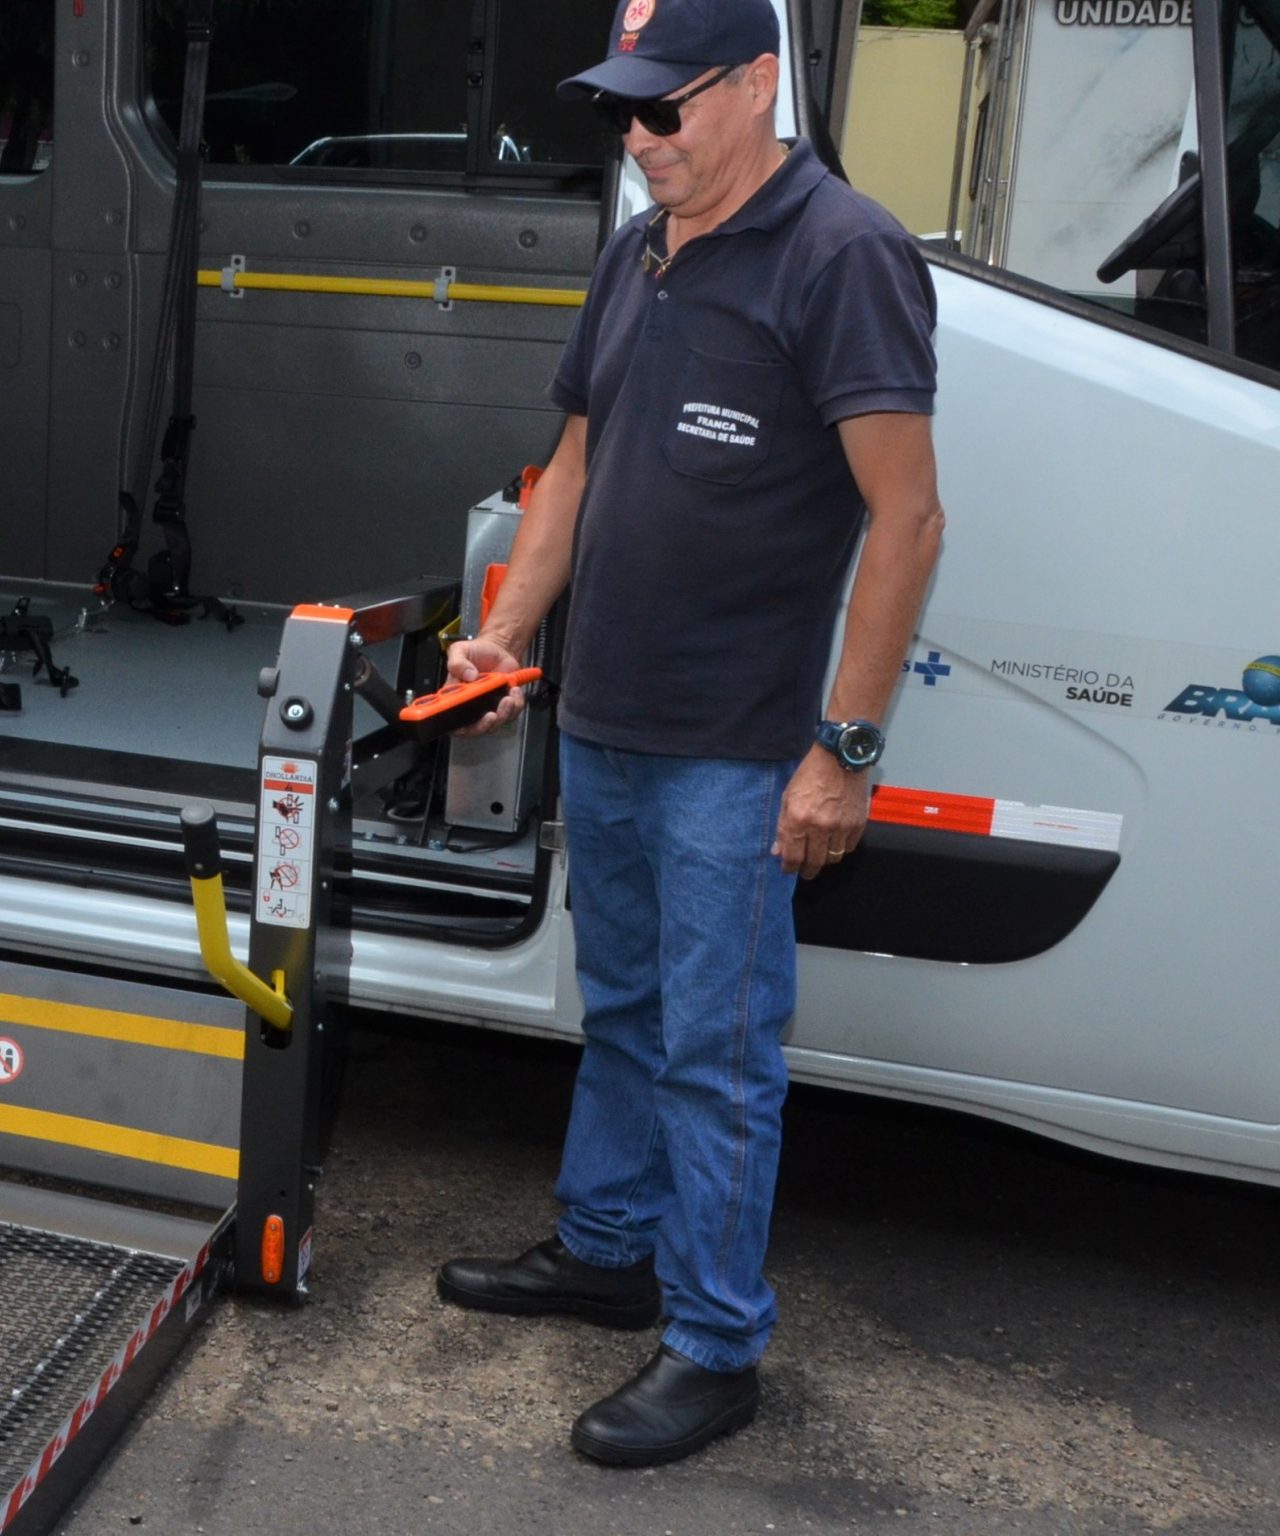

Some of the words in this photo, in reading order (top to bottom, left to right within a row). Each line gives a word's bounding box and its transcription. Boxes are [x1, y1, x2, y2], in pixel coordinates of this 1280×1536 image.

[697, 415, 736, 432] FRANCA
[721, 408, 759, 429] MUNICIPAL
[676, 422, 717, 440] SECRETARIA
[717, 432, 729, 443] DE
[729, 434, 756, 446] SAÚDE
[990, 659, 1099, 685] MINISTÉRIO
[1105, 673, 1135, 689] DA
[1066, 686, 1134, 708] SAÚDE
[1156, 713, 1257, 733] GOVERNO
